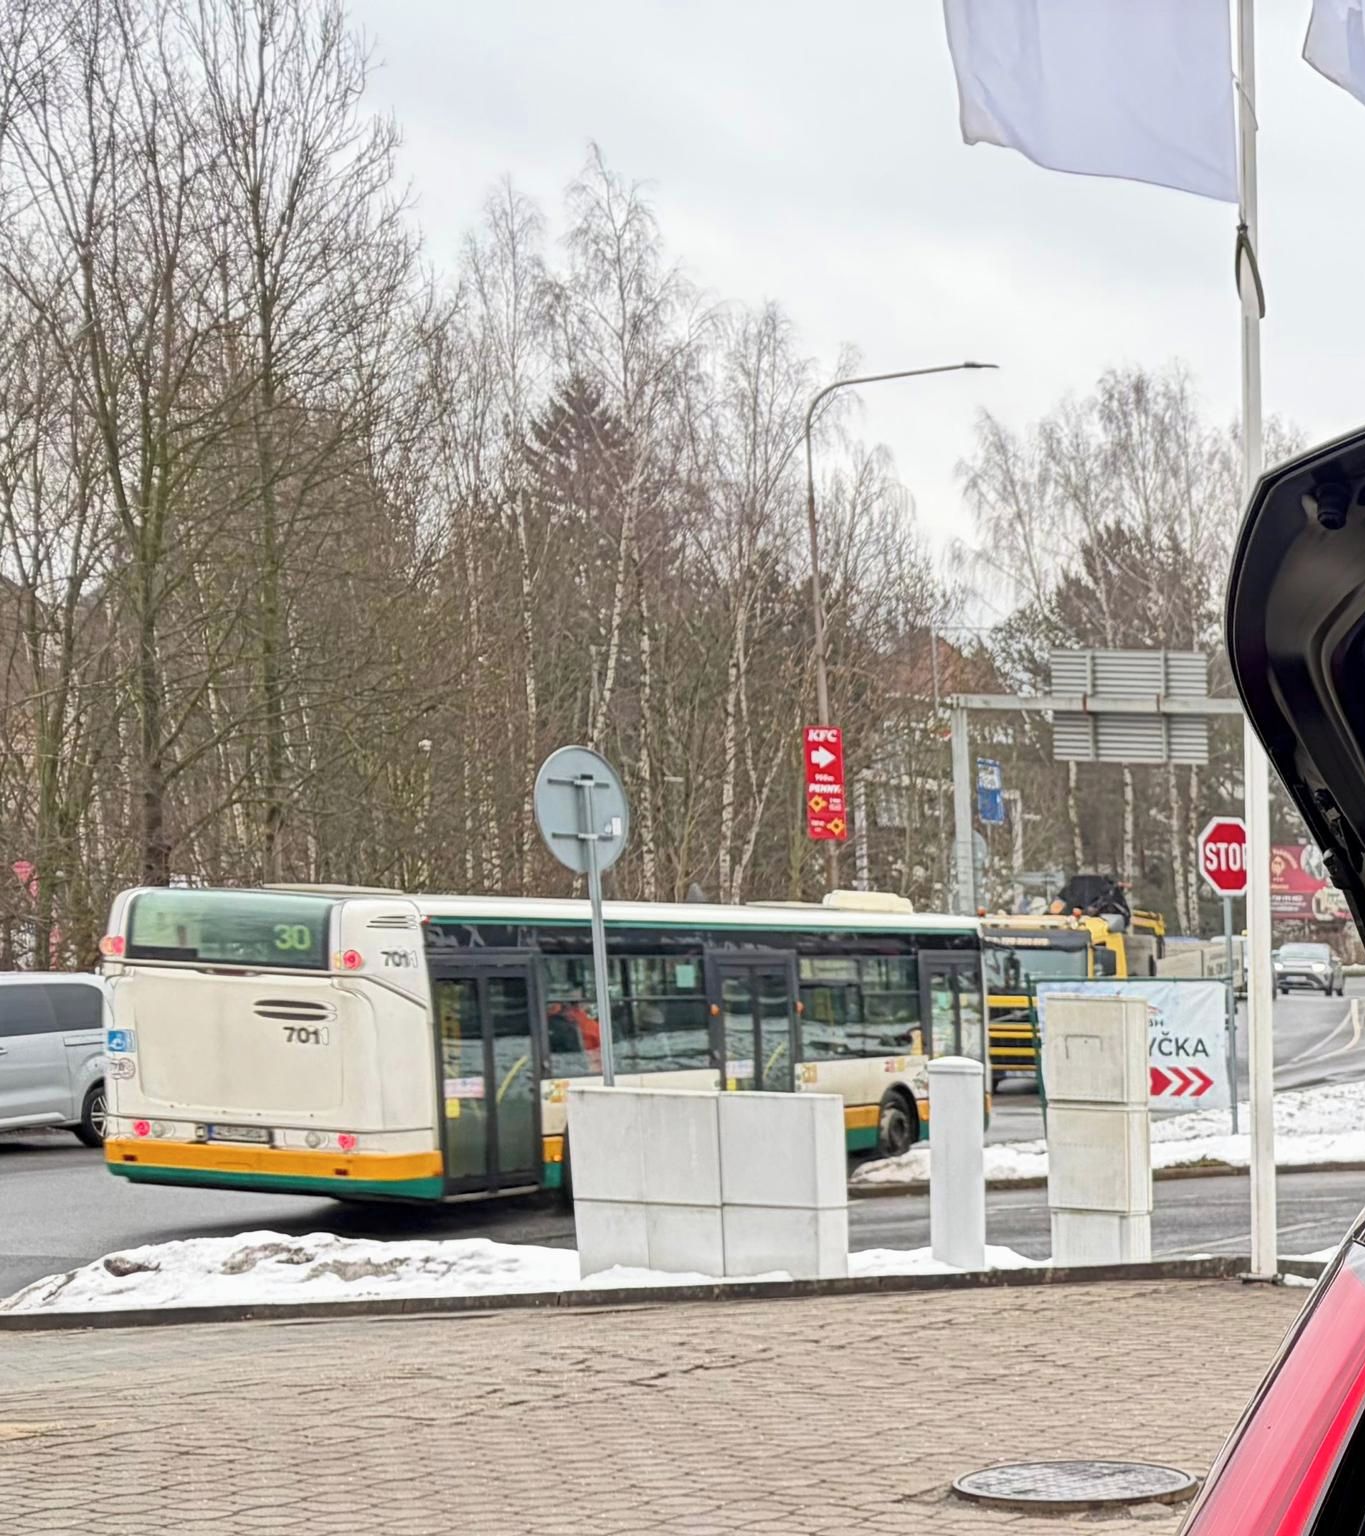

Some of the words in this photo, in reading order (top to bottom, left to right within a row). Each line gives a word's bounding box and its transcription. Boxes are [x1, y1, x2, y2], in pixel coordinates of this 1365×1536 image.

[808, 729, 838, 743] KFC
[1205, 842, 1247, 872] STO
[274, 924, 312, 950] 30
